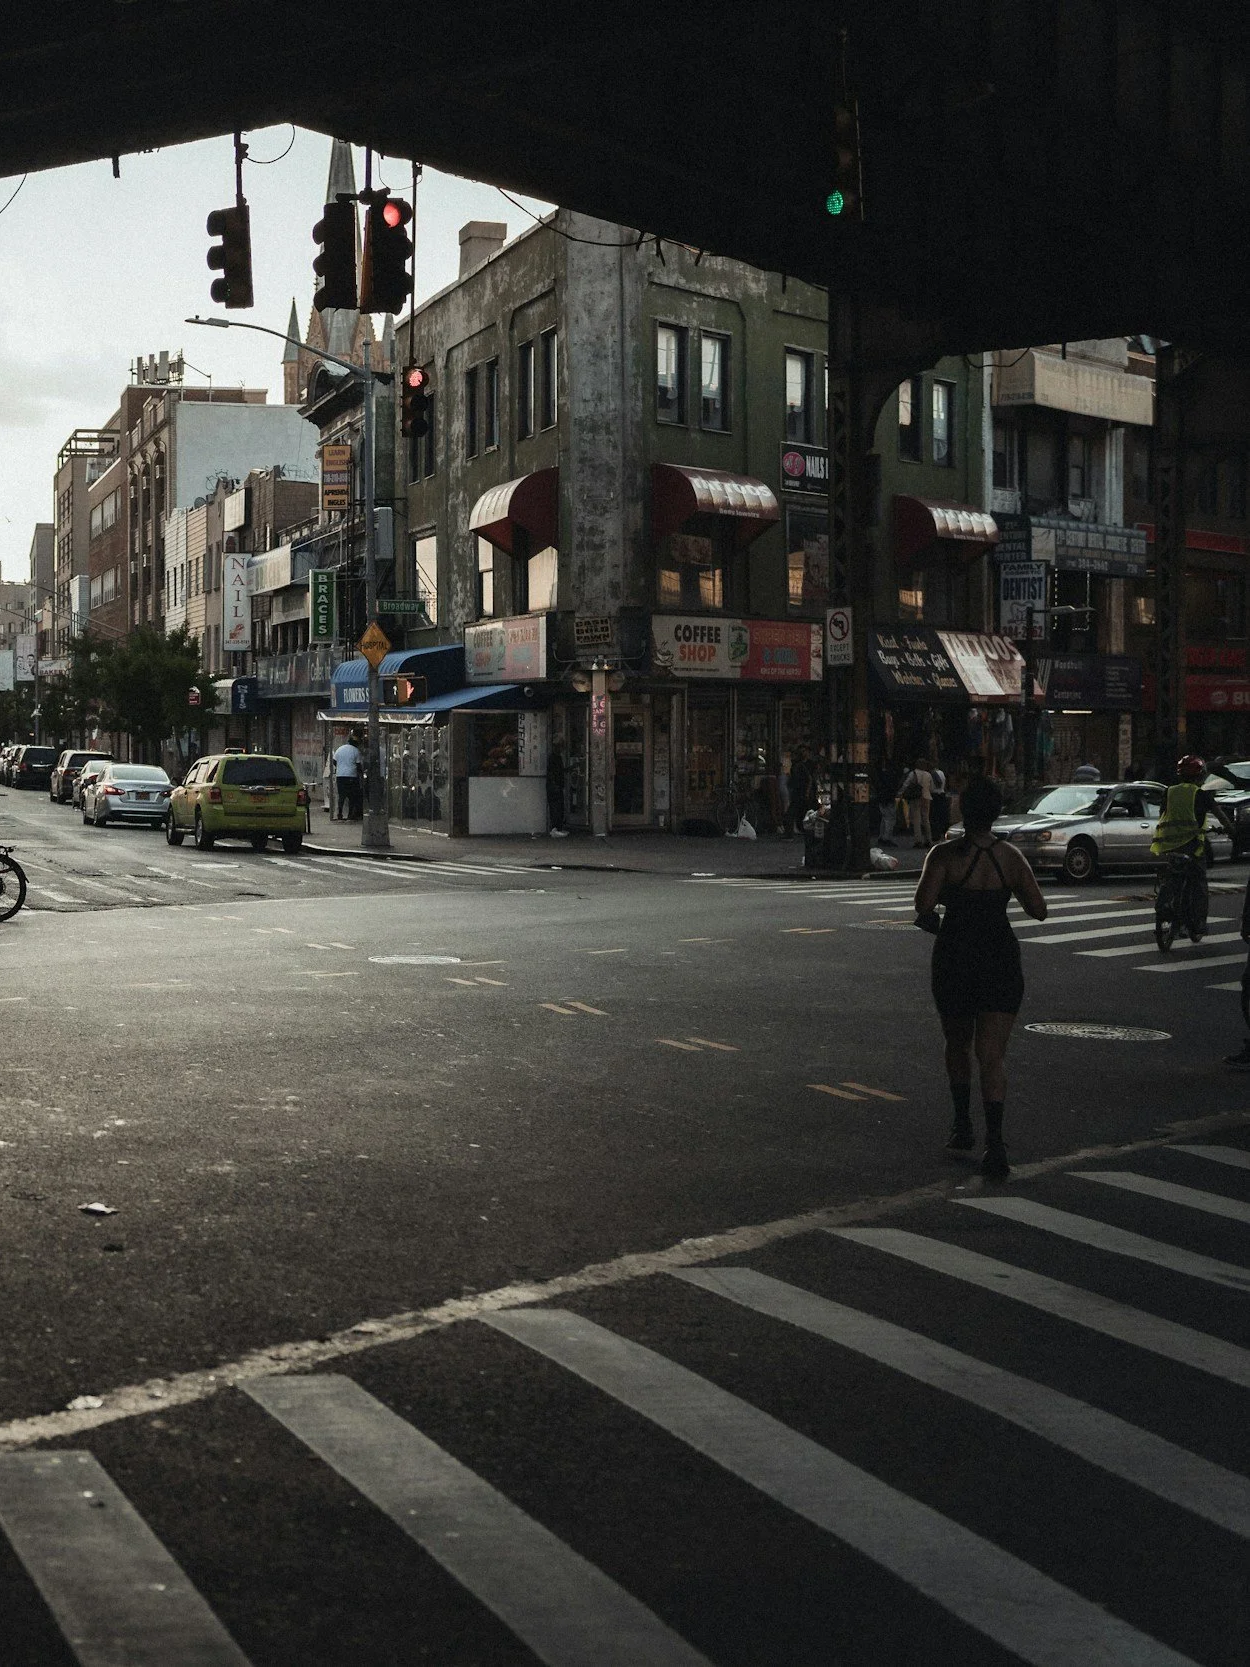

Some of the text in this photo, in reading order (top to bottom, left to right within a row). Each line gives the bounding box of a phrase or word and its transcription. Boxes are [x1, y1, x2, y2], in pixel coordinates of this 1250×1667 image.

[1002, 563, 1043, 571] FAMILY
[231, 557, 246, 618] NAIL
[1002, 576, 1043, 600] DENTIST
[316, 574, 329, 634] BRACES
[383, 601, 420, 612] Broadway
[674, 624, 721, 643] COFFEE
[361, 641, 387, 650] HOSPITAL
[679, 644, 717, 662] SHOP
[830, 643, 849, 651] EXCEPT
[937, 632, 1022, 661] TATTOOS
[830, 653, 850, 661] TRUCKS
[343, 687, 365, 703] FLOWERS
